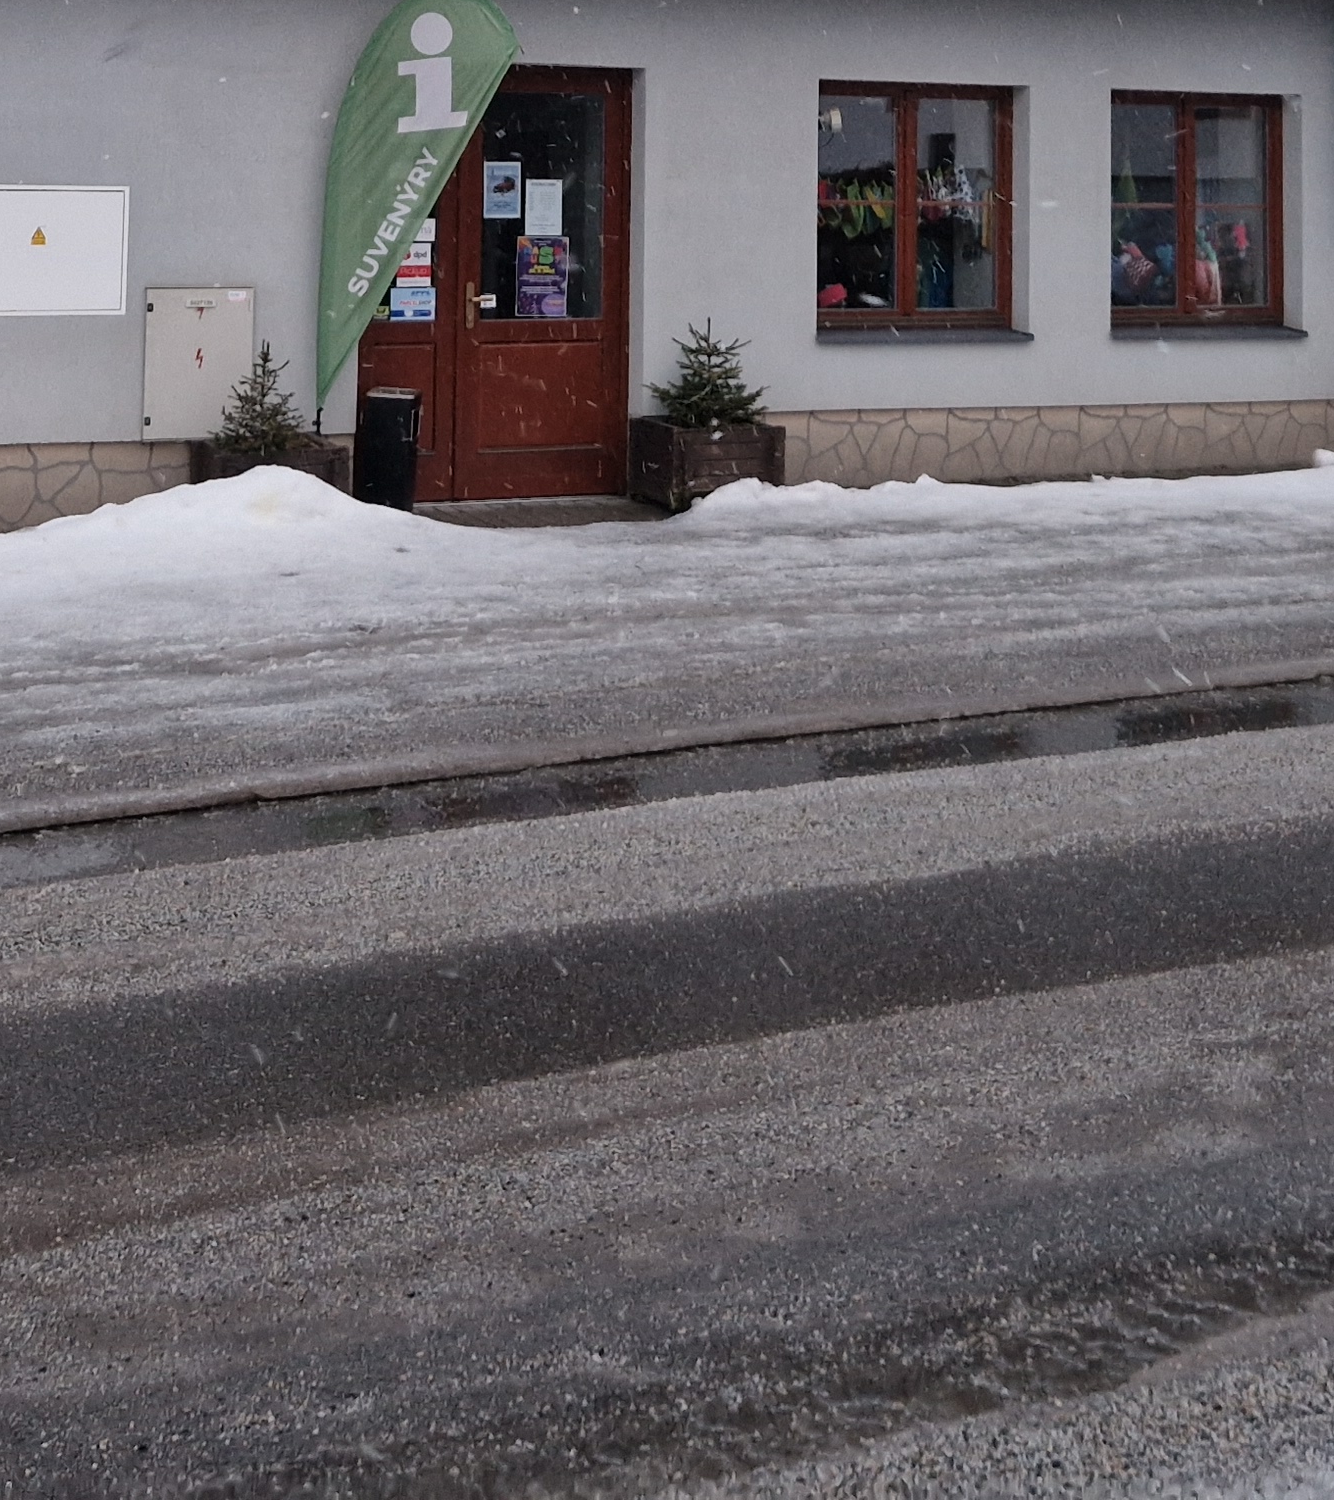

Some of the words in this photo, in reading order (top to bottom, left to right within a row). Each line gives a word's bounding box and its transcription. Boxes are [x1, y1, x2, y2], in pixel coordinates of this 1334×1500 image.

[397, 12, 468, 134] i
[348, 147, 438, 297] SUVENÝRY
[413, 251, 427, 259] dpd
